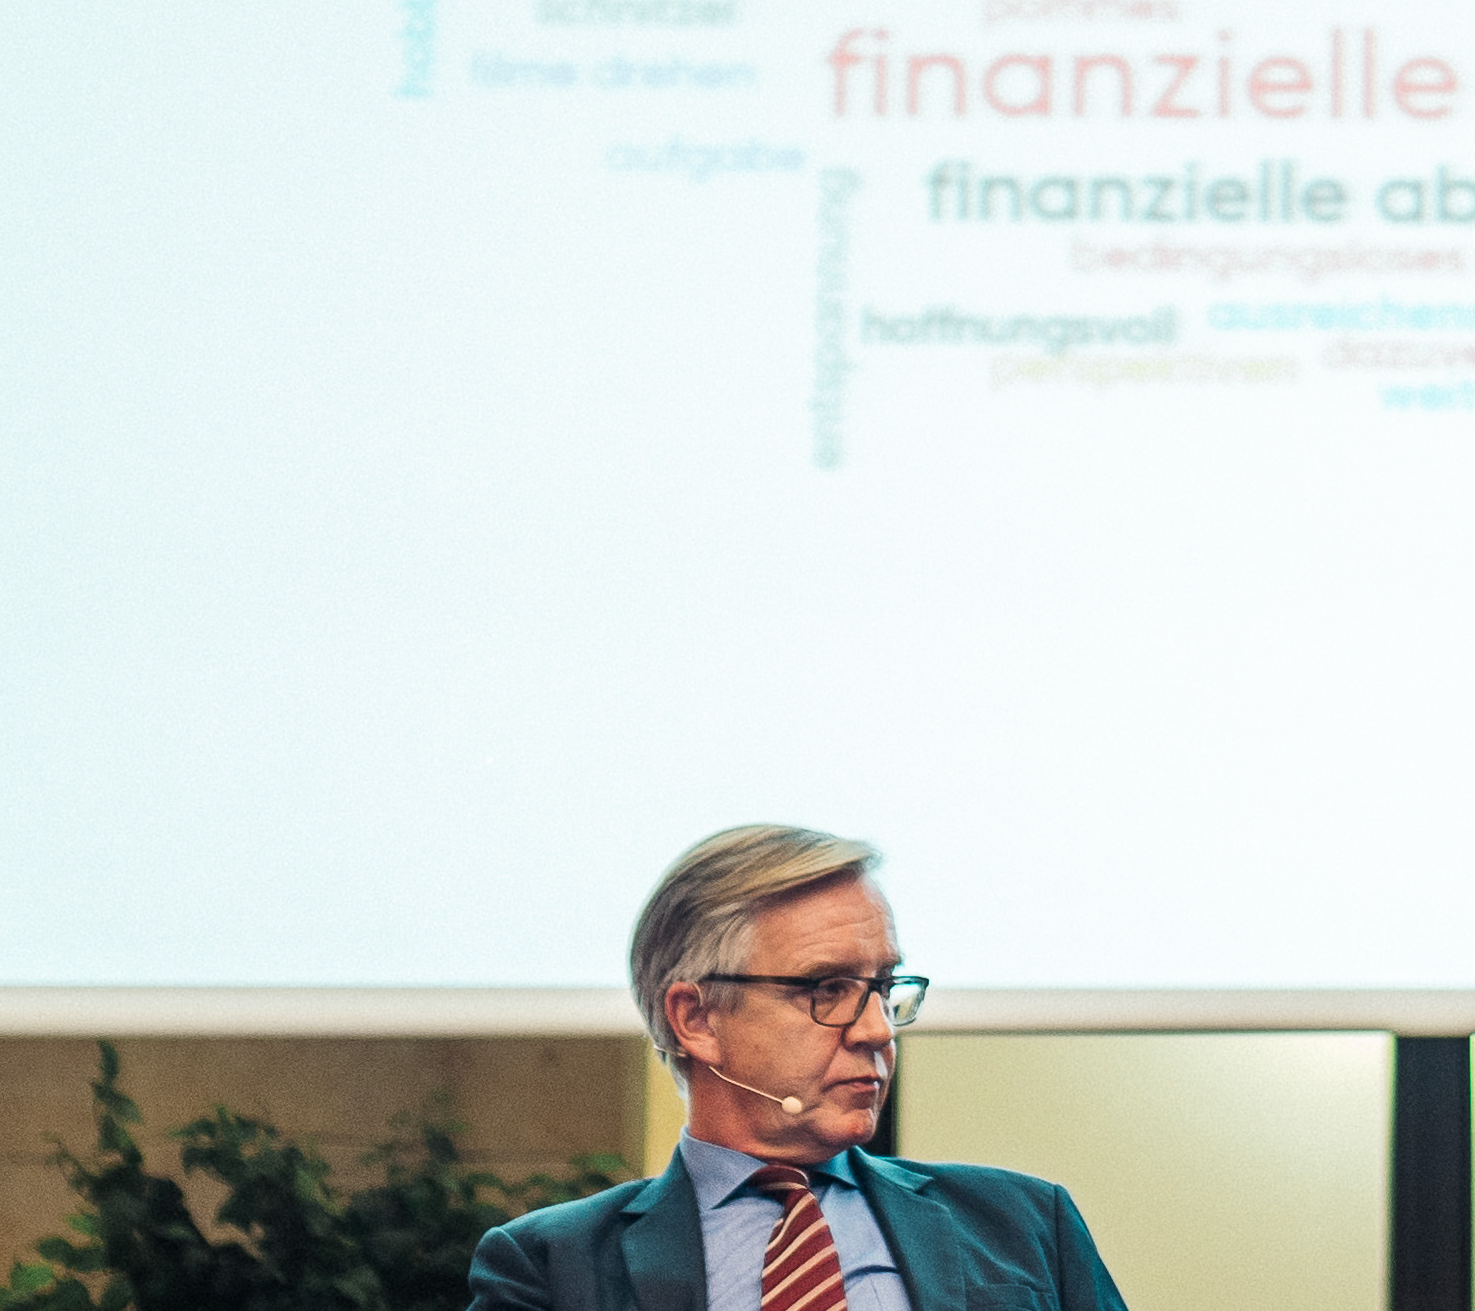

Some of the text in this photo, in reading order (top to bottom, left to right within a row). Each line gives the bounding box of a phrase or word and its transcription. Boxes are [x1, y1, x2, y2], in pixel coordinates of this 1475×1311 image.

[467, 49, 759, 90] filme drehen
[823, 26, 1461, 124] finanzielle
[603, 135, 807, 180] aufgabe
[927, 158, 1349, 224] finanzielle
[1069, 237, 1466, 280] bedingungsloses
[859, 301, 1179, 356] hoffnungsvoll
